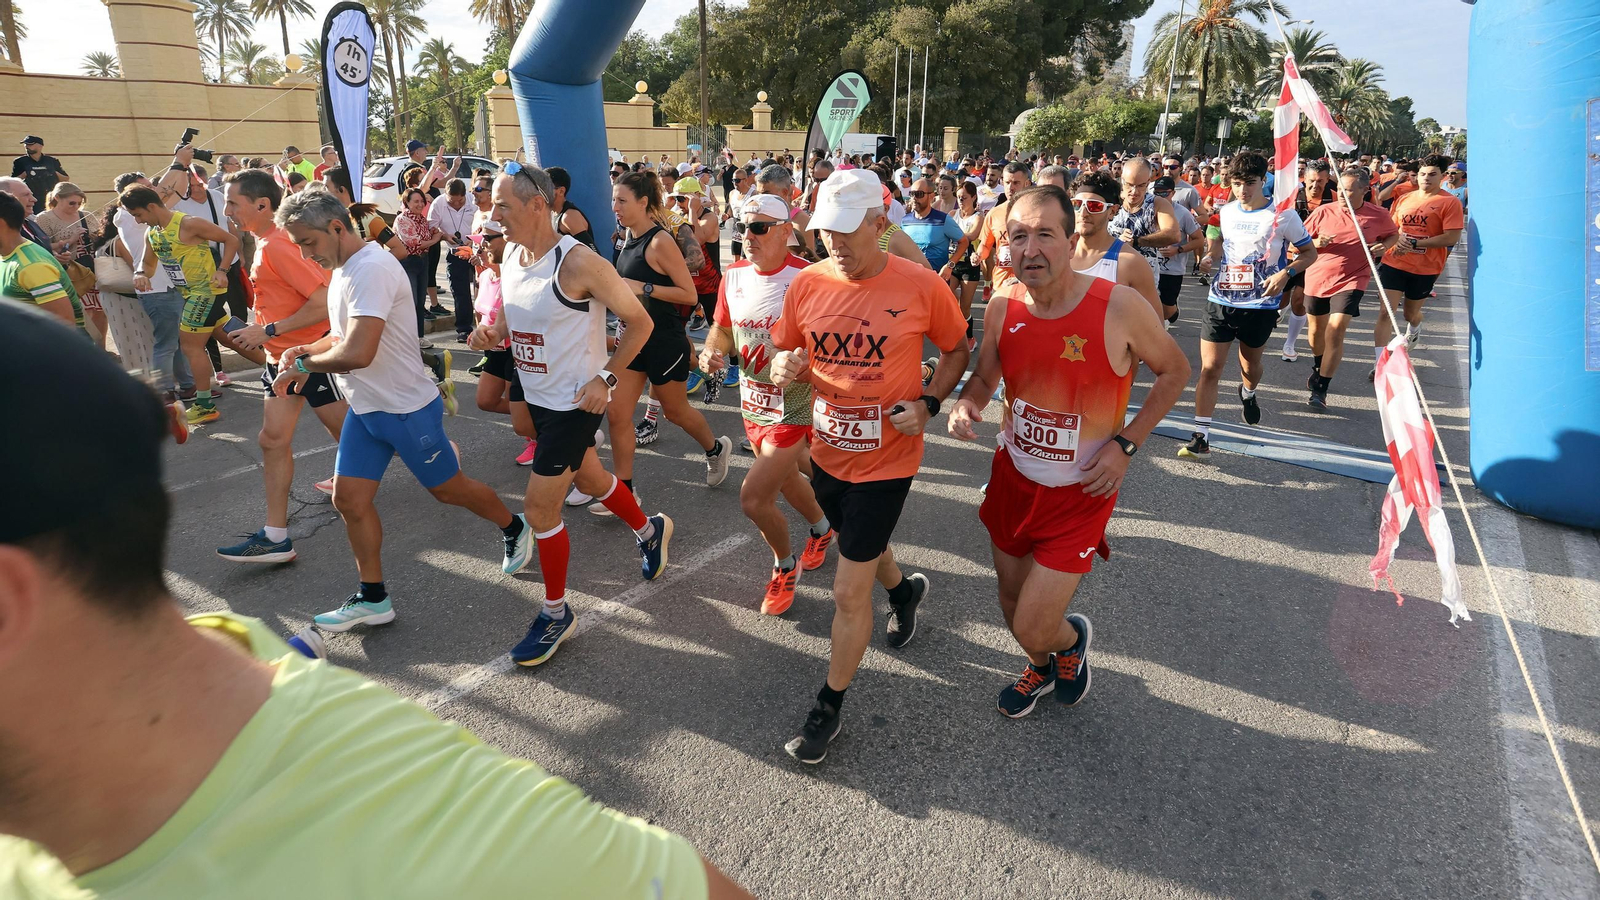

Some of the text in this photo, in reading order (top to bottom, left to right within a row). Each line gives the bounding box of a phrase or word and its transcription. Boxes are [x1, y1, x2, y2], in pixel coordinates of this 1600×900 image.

[346, 44, 361, 61] 1h
[340, 62, 361, 78] 45'
[1232, 223, 1259, 231] JEREZ
[1225, 273, 1244, 282] 319
[515, 344, 535, 360] 413
[834, 359, 871, 367] MARATÓN
[750, 391, 771, 406] 407
[828, 419, 863, 437] 276
[1023, 422, 1058, 446] 300
